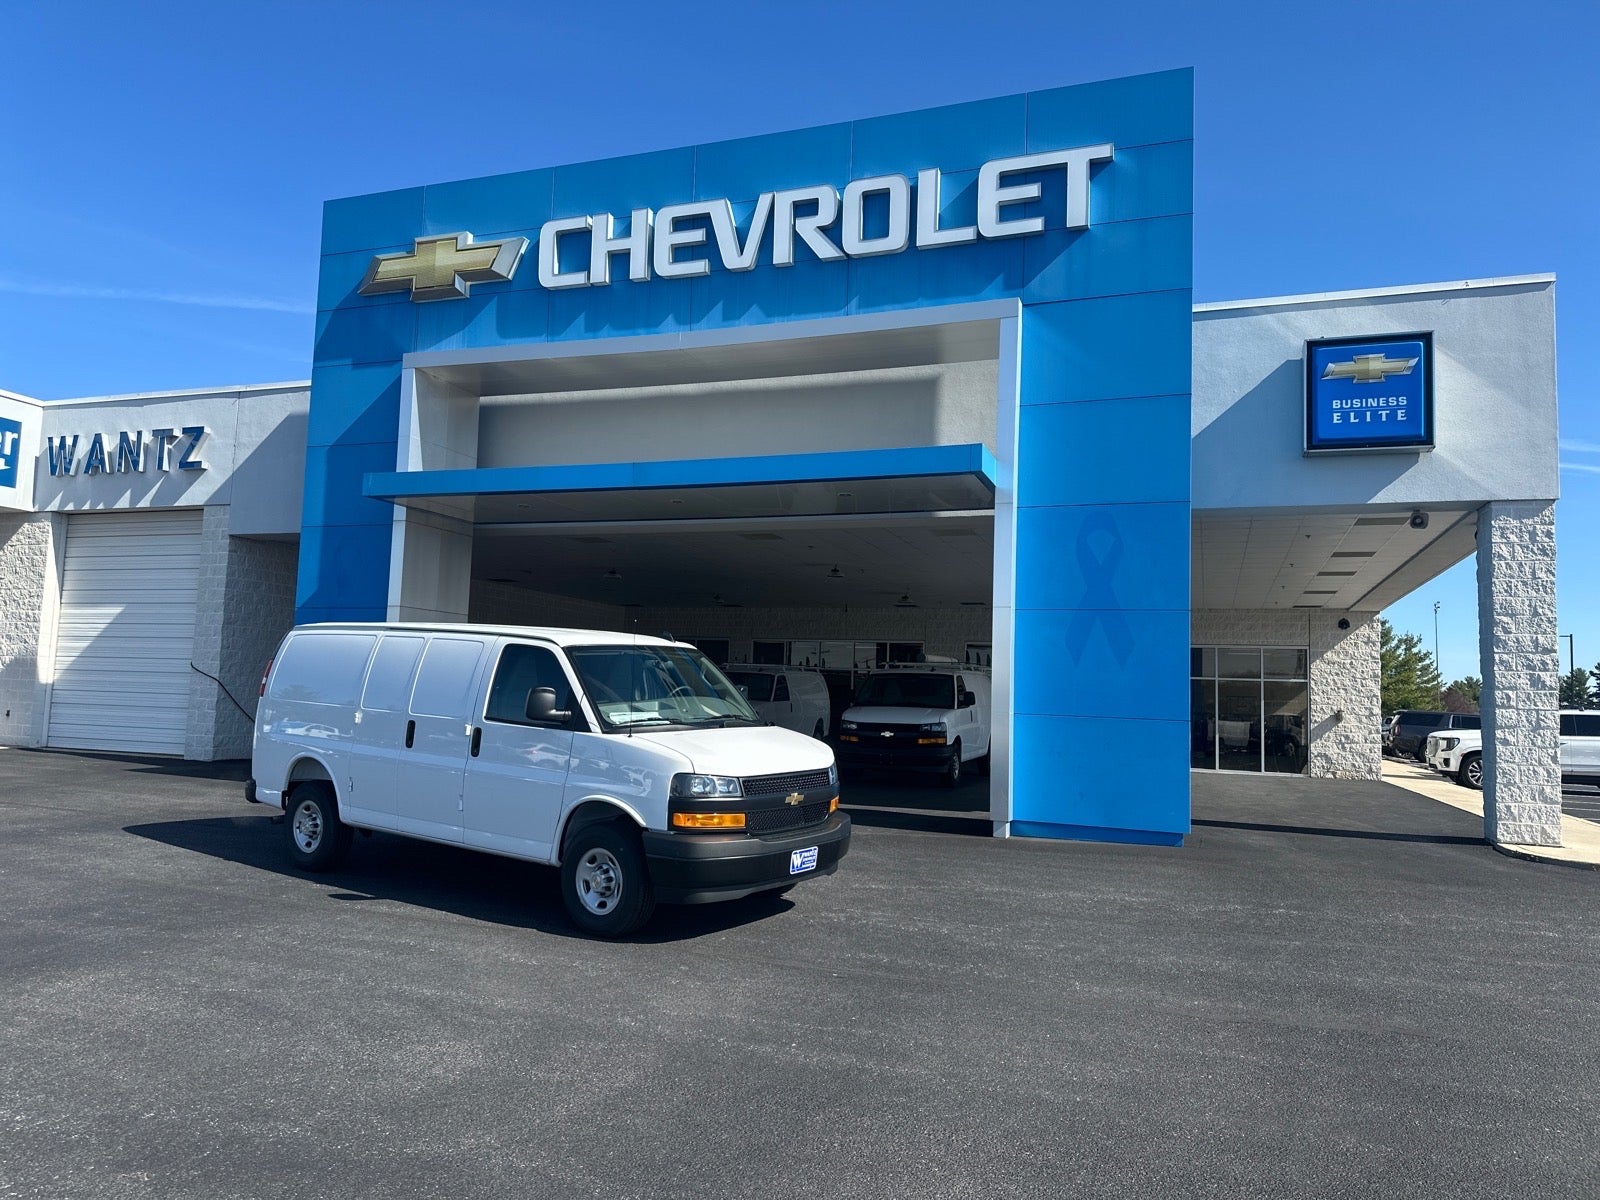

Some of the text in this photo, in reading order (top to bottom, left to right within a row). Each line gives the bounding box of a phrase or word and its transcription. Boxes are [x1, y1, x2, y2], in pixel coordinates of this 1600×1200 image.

[539, 143, 1114, 290] CHEVROLET
[1332, 396, 1407, 409] BUSINESS
[1332, 410, 1407, 424] ELITE
[47, 426, 208, 477] WANTZ
